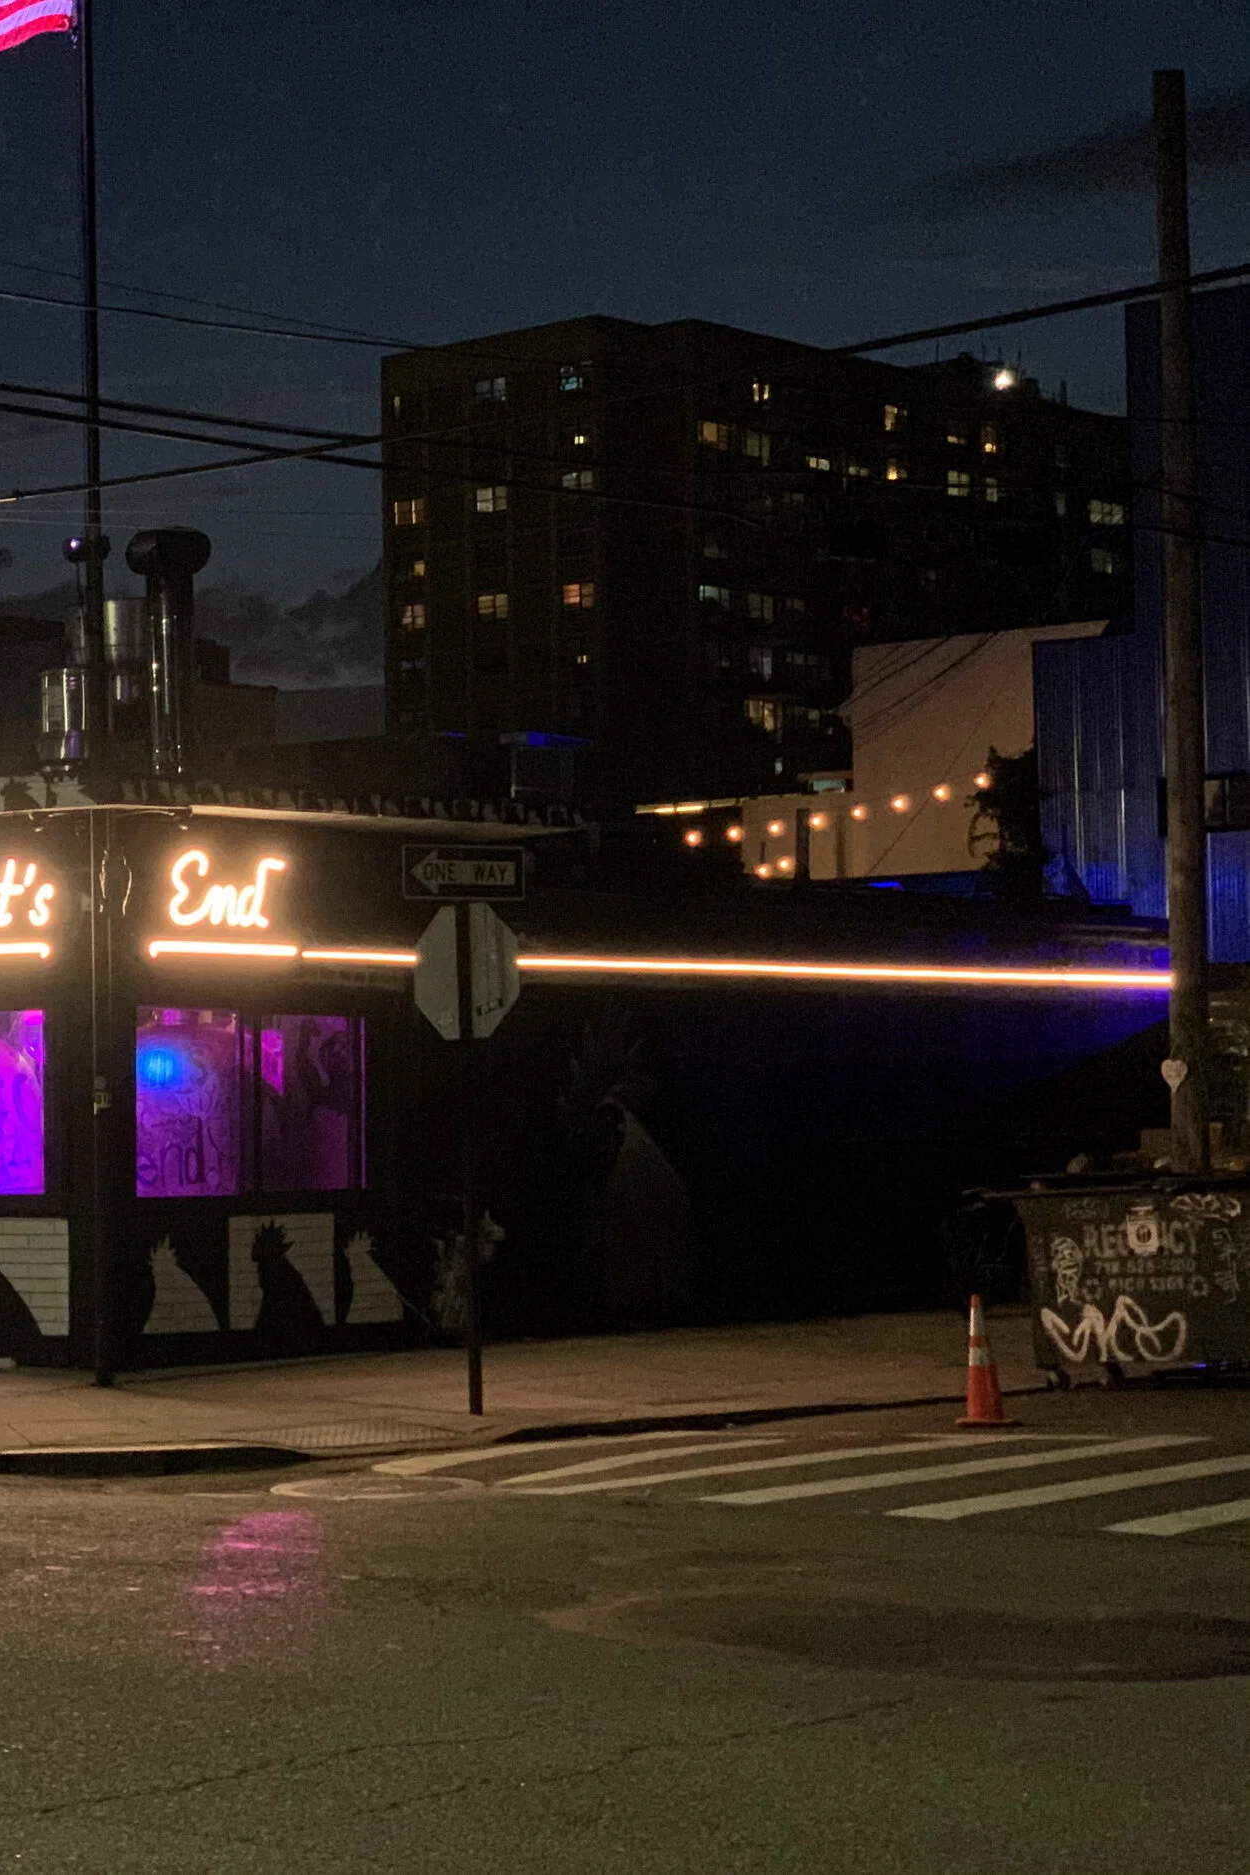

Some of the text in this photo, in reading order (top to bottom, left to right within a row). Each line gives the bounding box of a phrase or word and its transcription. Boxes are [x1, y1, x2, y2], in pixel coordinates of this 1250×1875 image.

[168, 849, 286, 929] End
[423, 862, 508, 882] ONE WAY
